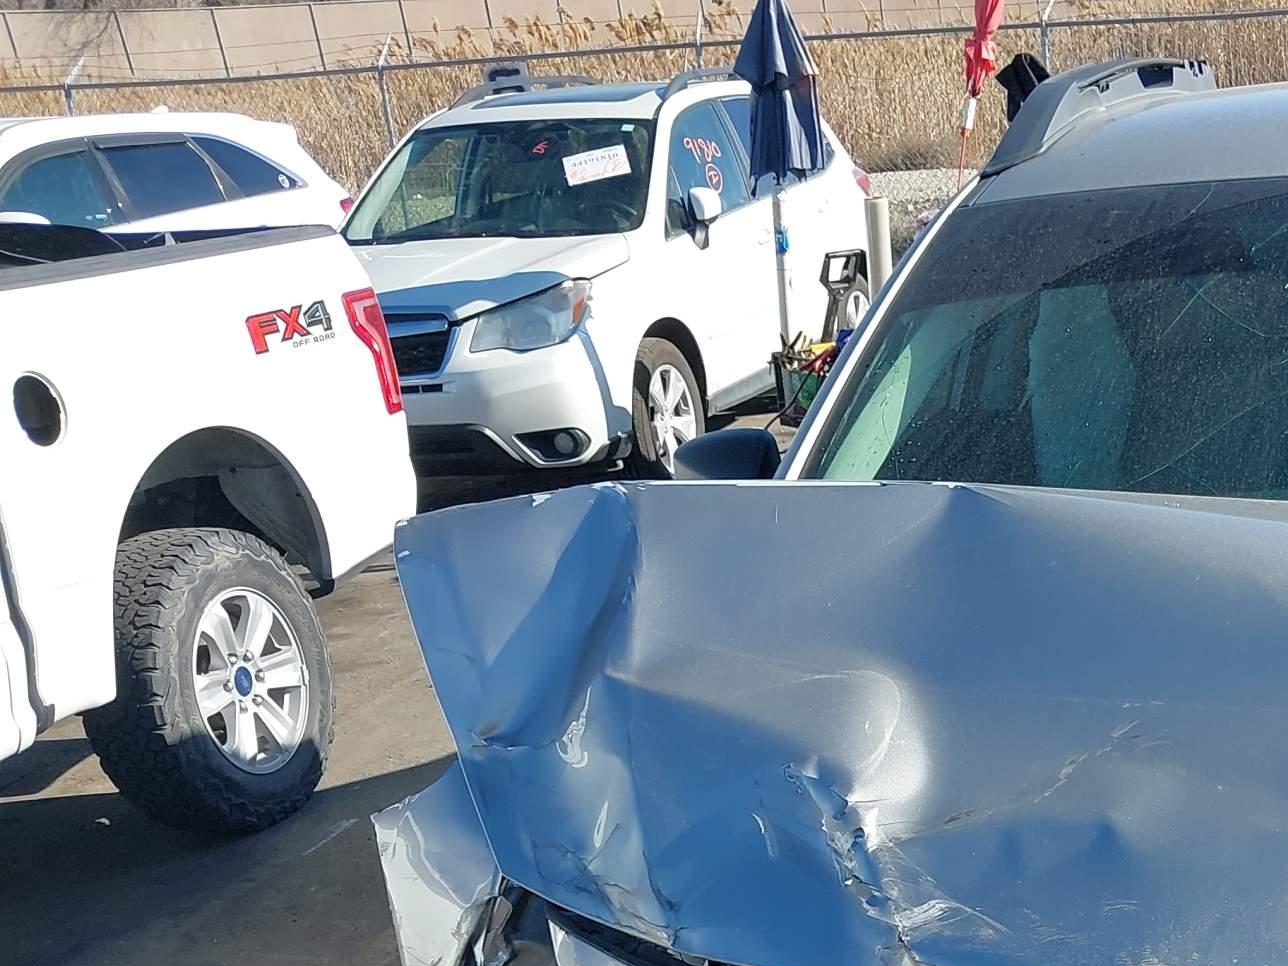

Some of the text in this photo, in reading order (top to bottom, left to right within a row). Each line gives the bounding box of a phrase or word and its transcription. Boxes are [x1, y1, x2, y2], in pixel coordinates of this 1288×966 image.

[683, 137, 721, 164] 91810
[245, 299, 333, 355] FX4
[293, 332, 336, 348] OFF ROAD
